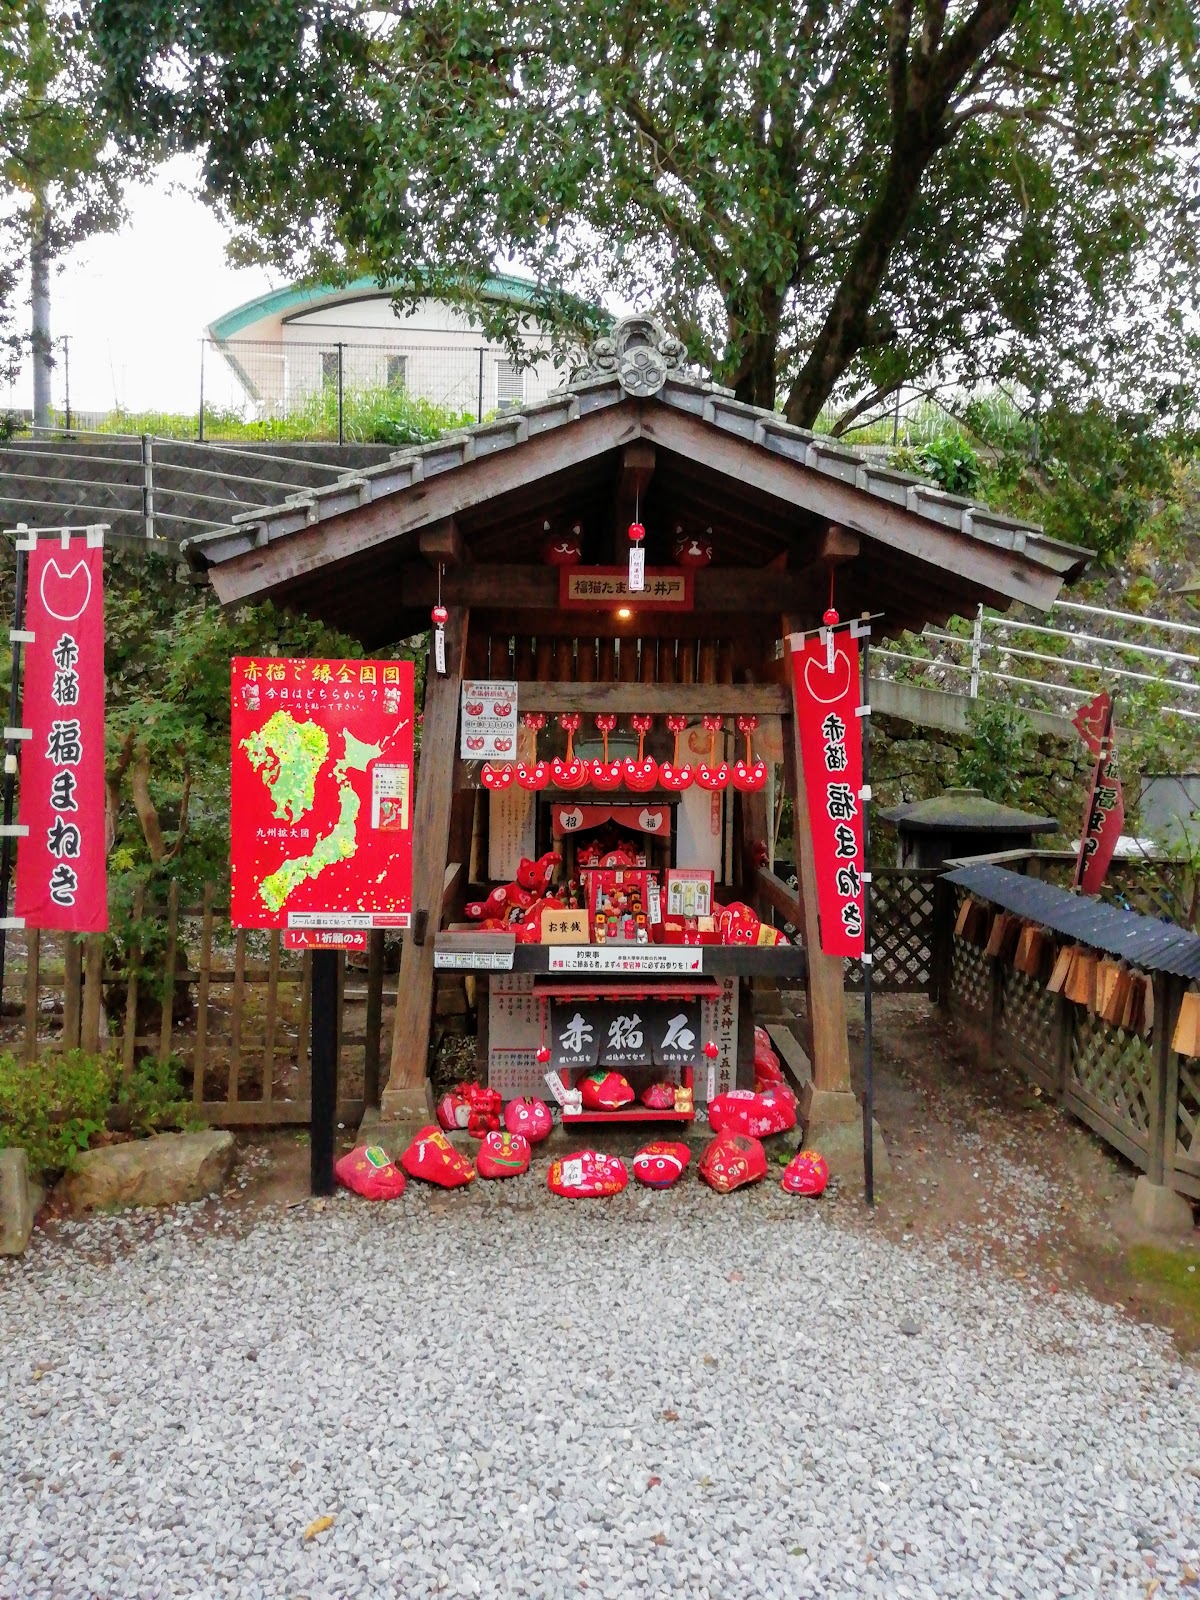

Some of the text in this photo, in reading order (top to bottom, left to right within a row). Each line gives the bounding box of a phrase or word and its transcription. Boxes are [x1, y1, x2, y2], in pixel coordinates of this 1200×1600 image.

[574, 580, 681, 595] 福猫たまの井戸
[243, 661, 400, 685] 赤猫ご縁全国図
[46, 634, 82, 906] 赤猫 福まねき
[566, 816, 577, 827] 招
[646, 818, 656, 828] 福
[256, 827, 310, 838] 九州拡大図
[549, 922, 582, 933] お賽銭
[315, 933, 364, 944] 1祈願のみ
[559, 1013, 696, 1052] 赤猫石
